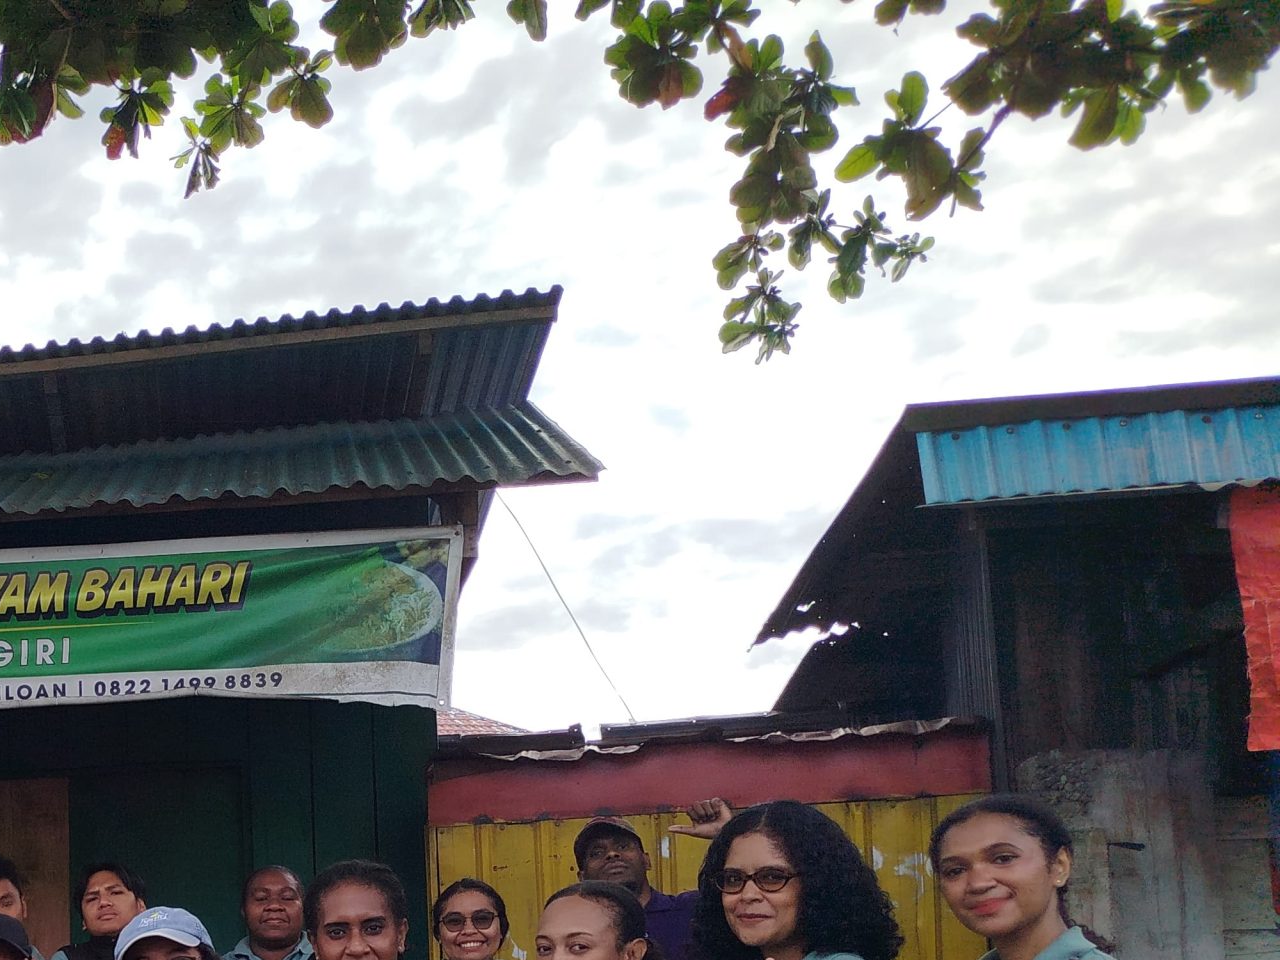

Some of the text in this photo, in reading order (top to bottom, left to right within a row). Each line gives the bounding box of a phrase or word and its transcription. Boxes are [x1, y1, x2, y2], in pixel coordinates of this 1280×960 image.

[75, 560, 251, 613] BAHARI
[94, 679, 151, 697] 0822
[161, 677, 216, 691] 1499
[224, 672, 282, 689] 8839
